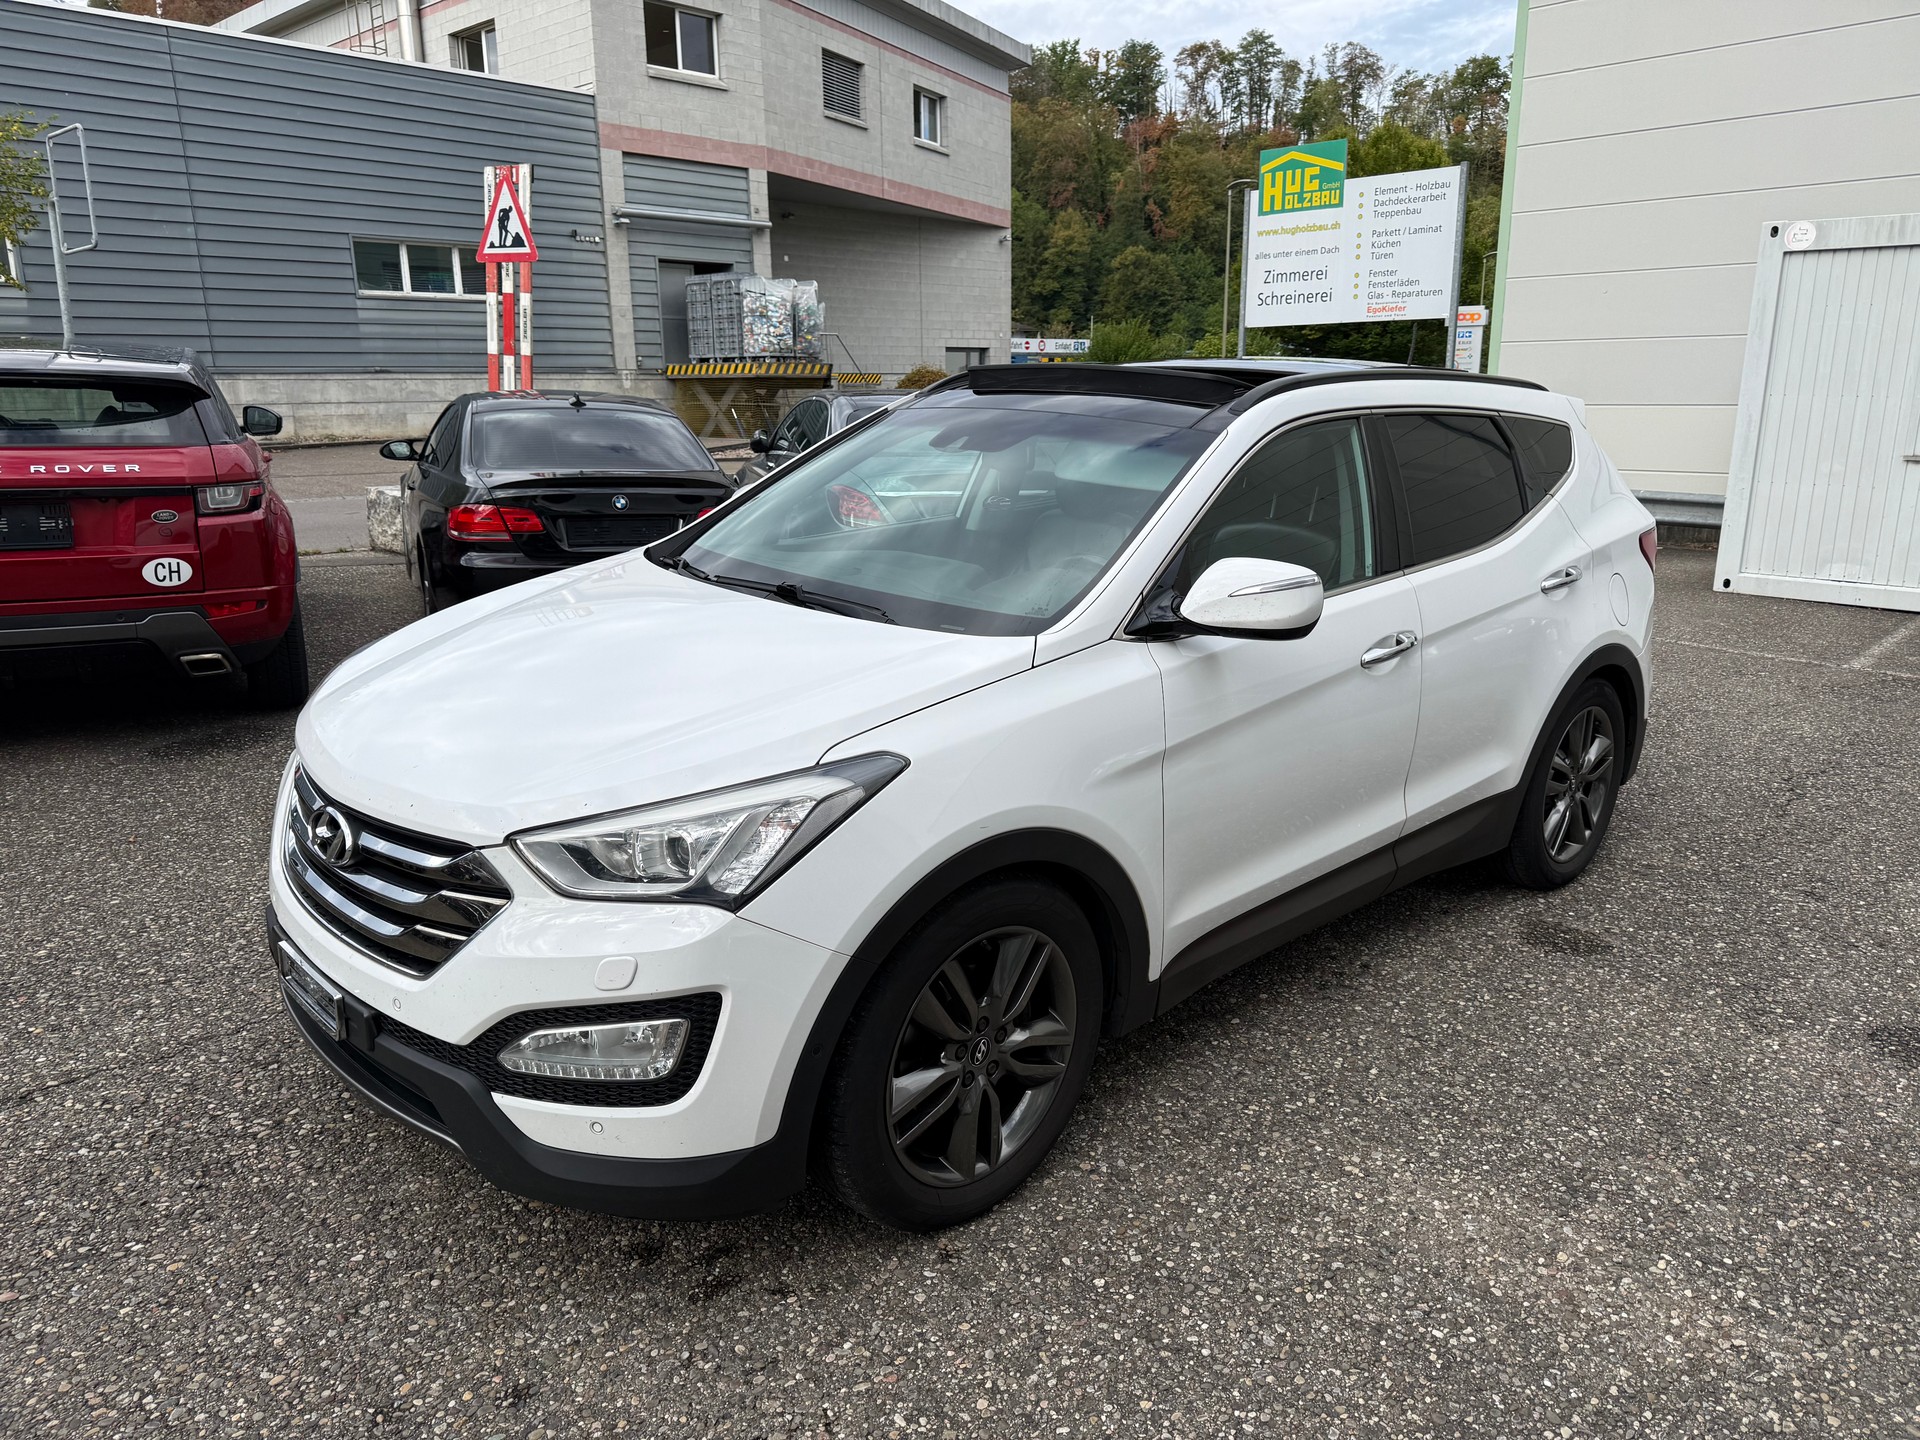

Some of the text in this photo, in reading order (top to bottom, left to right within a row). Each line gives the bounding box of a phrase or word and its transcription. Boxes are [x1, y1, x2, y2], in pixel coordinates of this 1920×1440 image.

[1263, 167, 1341, 212] HUG GmbH
[1374, 186, 1408, 196] Element
[1415, 181, 1451, 191] Holzbau
[1373, 192, 1447, 208] Dachdeckerarbeit
[1373, 207, 1422, 219] Treppenbau
[1257, 221, 1341, 237] www.hugholzbau.ch
[1371, 228, 1401, 238] Parkett
[1408, 225, 1443, 235] Laminat
[1371, 240, 1401, 249] Küchen
[1255, 245, 1340, 260] alles unter einem Dach
[1371, 252, 1394, 260] Türen
[1264, 265, 1328, 284] Zimmerei
[1368, 269, 1398, 277] Fenster
[1368, 278, 1420, 289] Fensterläden
[1257, 287, 1332, 306] Schreinerei
[1367, 291, 1384, 300] Glas
[1391, 289, 1443, 299] Reparaturen
[1367, 305, 1407, 314] EgoKiefer
[1457, 313, 1482, 323] oop
[30, 464, 141, 473] ROVER
[154, 562, 181, 582] CH
